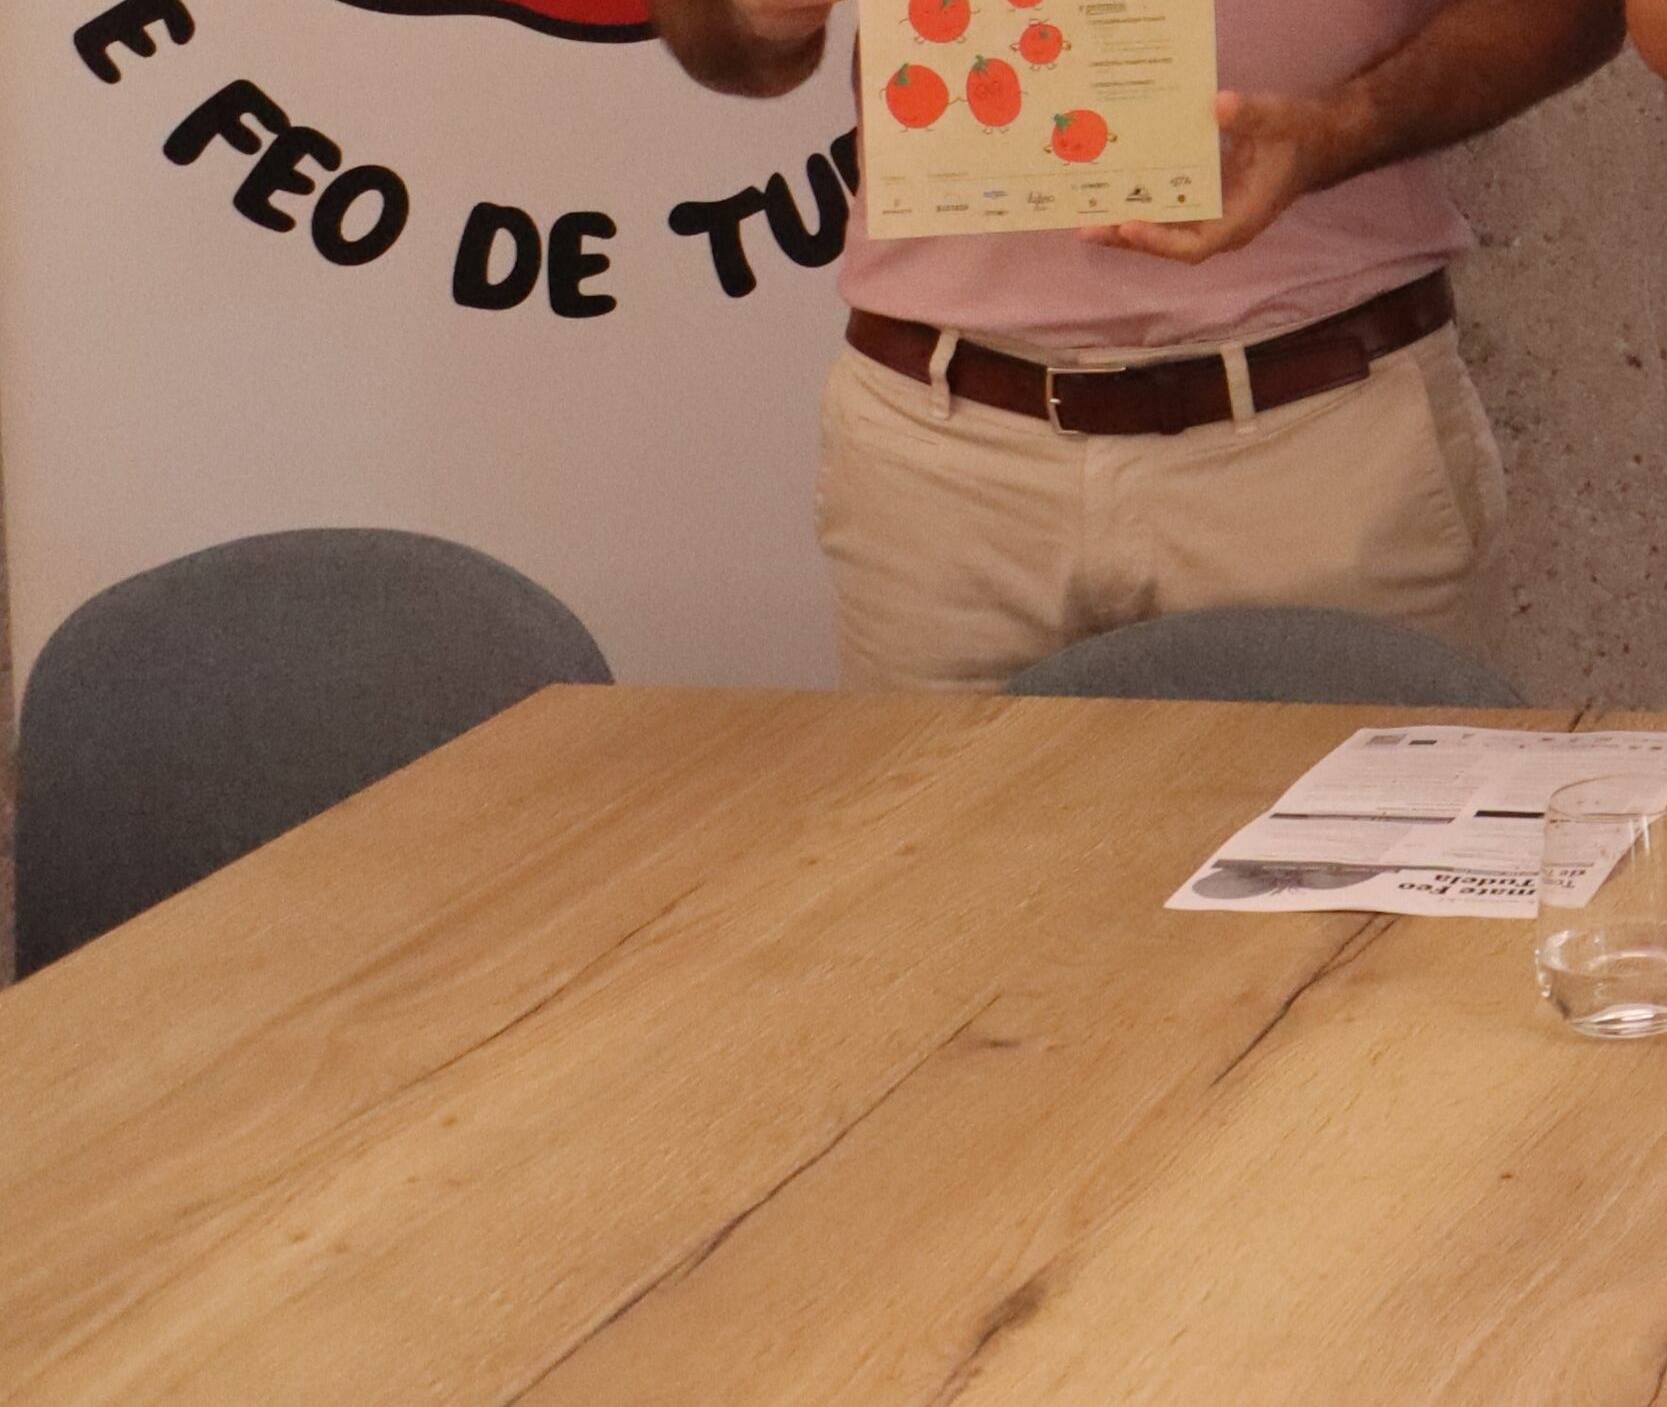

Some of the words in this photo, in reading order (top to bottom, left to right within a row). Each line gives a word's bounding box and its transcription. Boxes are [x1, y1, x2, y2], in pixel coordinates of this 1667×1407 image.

[163, 77, 410, 266] FEO
[452, 201, 619, 319] DE
[1398, 881, 1451, 895] Feo
